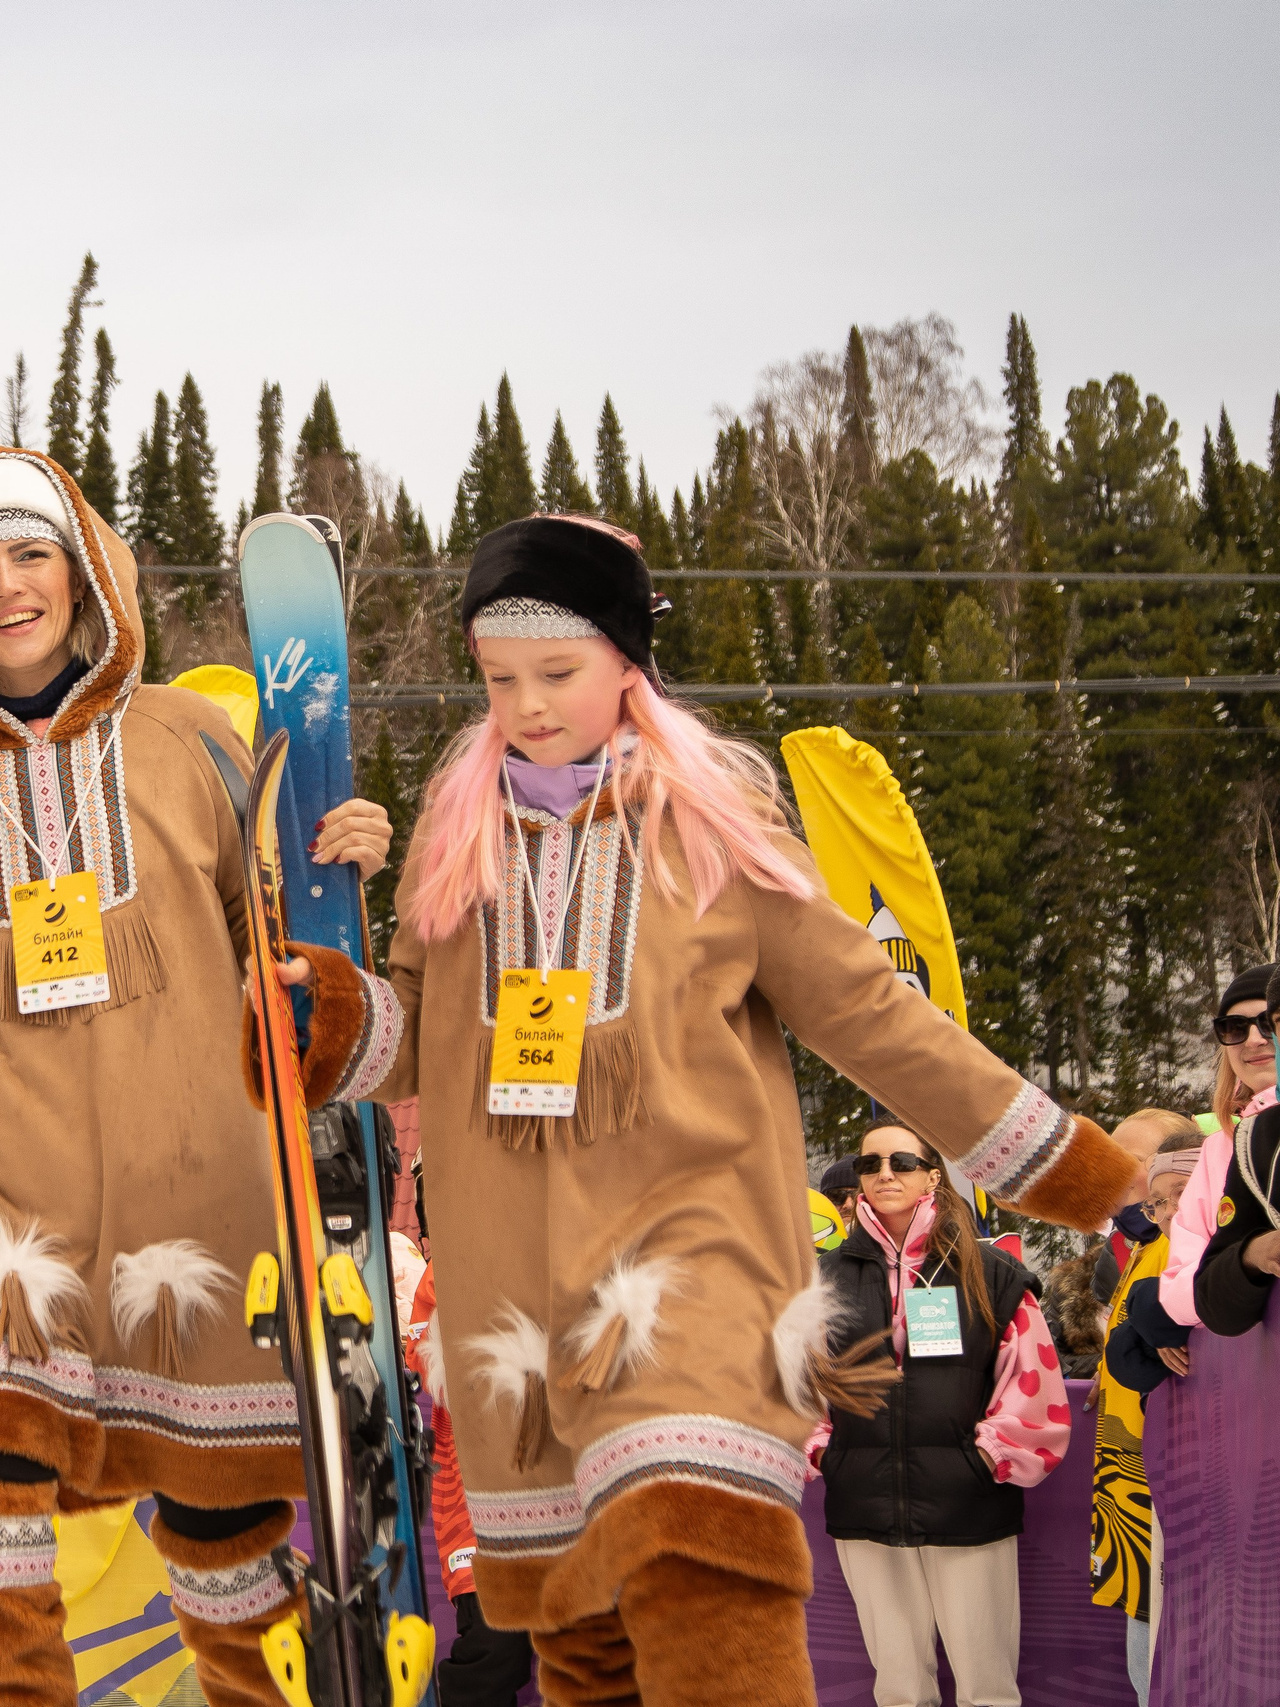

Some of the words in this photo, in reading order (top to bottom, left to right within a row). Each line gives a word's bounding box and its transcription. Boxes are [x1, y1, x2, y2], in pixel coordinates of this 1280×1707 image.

[264, 637, 314, 709] K2
[33, 927, 84, 946] билайн
[41, 946, 79, 965] 412
[514, 1027, 565, 1042] билайн
[518, 1048, 554, 1066] 564
